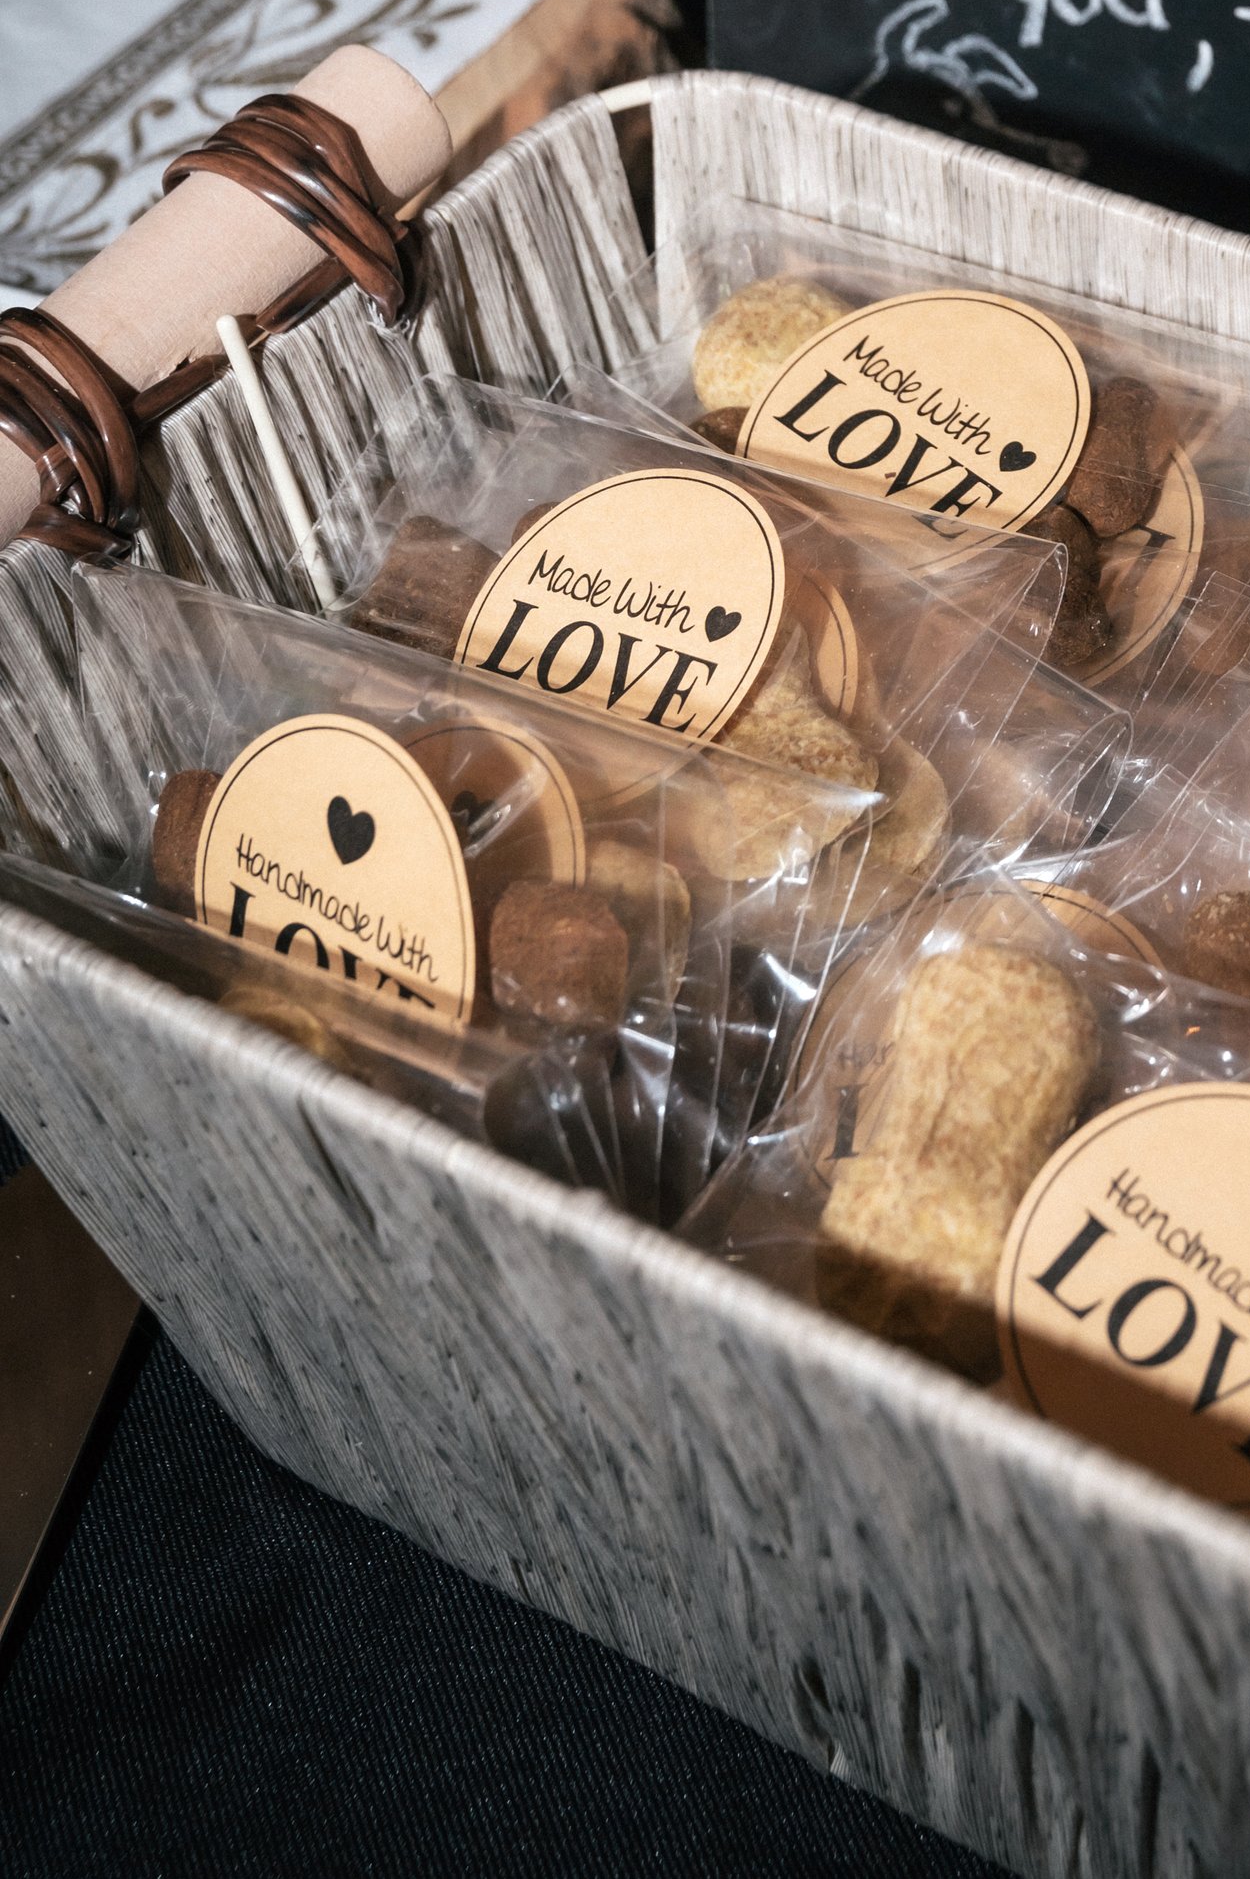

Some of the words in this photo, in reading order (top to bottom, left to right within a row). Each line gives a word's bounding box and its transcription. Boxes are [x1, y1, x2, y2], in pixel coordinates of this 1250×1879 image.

[773, 369, 1003, 539] LOVE
[843, 335, 922, 404] Made
[917, 387, 991, 455] With
[528, 549, 611, 608] Made
[612, 577, 695, 633] With
[476, 599, 718, 733] LOVE
[236, 833, 374, 942] Handmade
[376, 915, 439, 983] With
